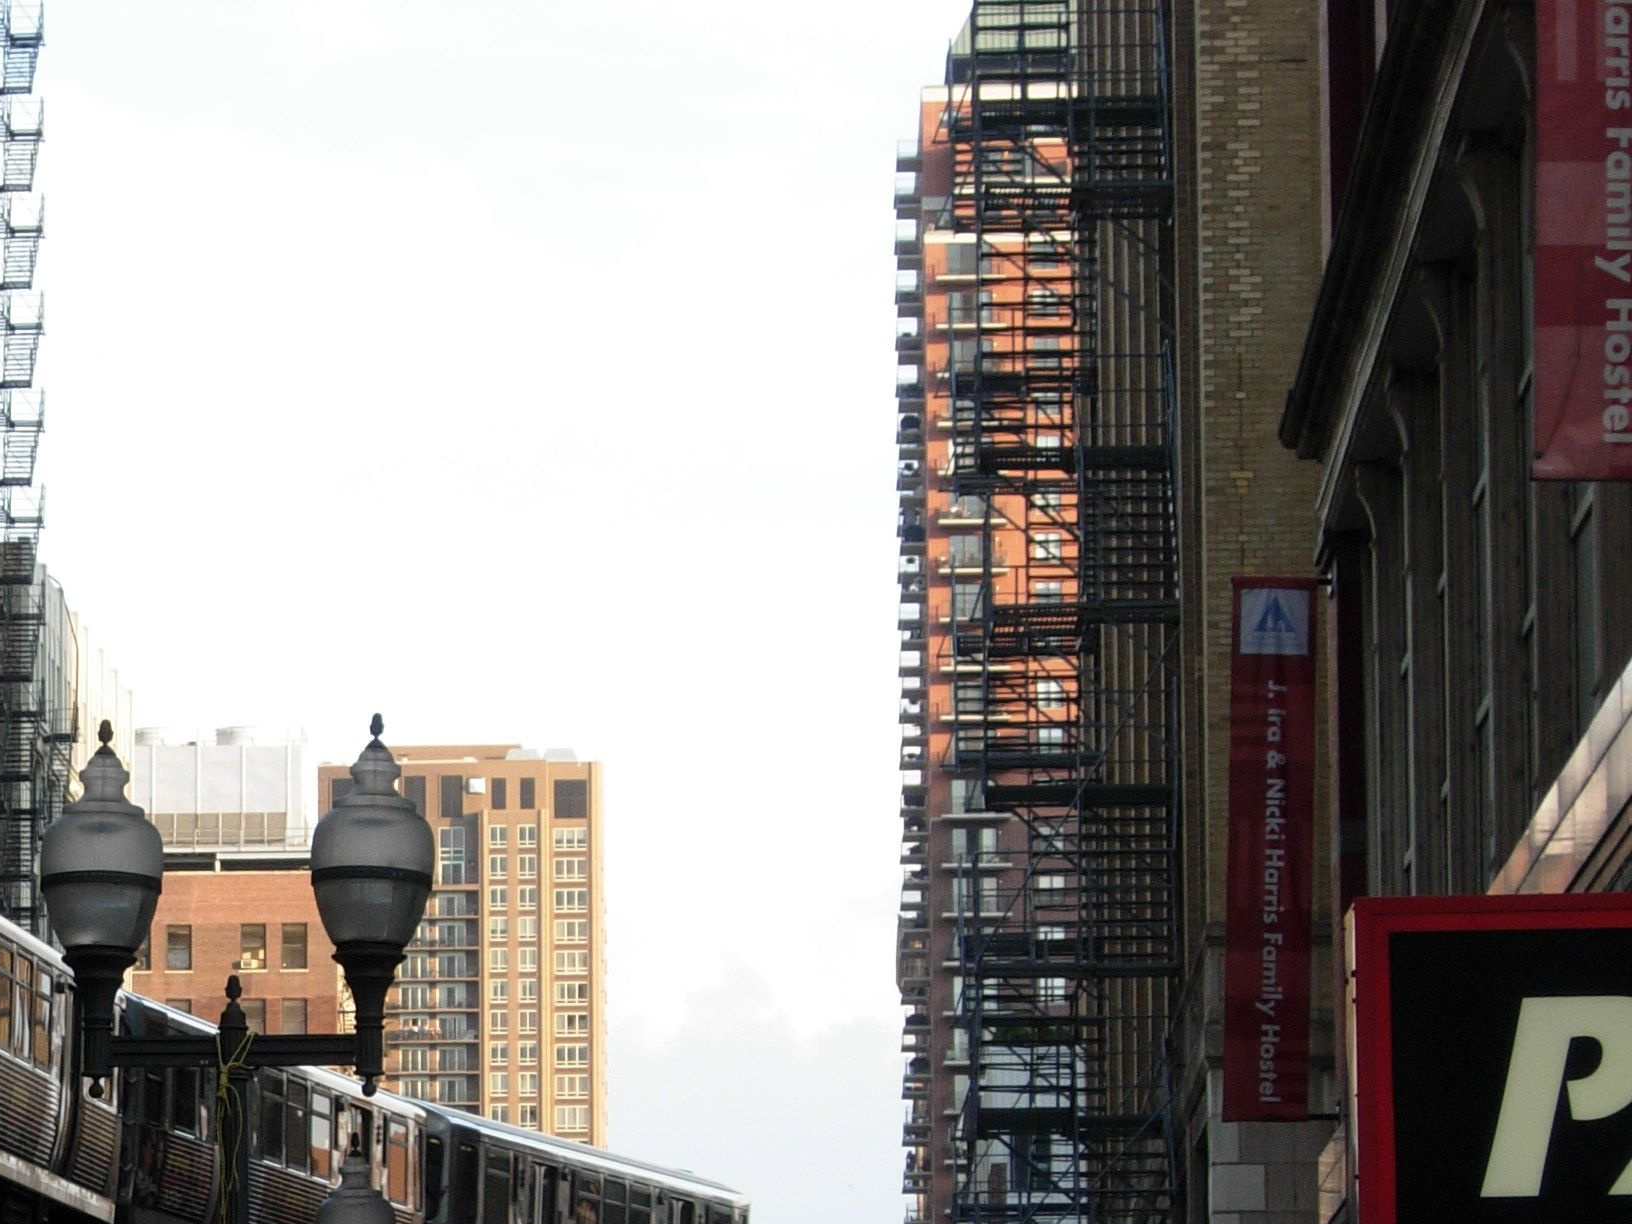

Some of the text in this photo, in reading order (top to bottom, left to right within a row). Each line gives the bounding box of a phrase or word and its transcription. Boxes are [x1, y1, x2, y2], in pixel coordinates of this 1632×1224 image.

[1594, 0, 1632, 443] arris Family Hostel
[1255, 679, 1288, 1104] J. Ira & Nicki Harris Family Hostel
